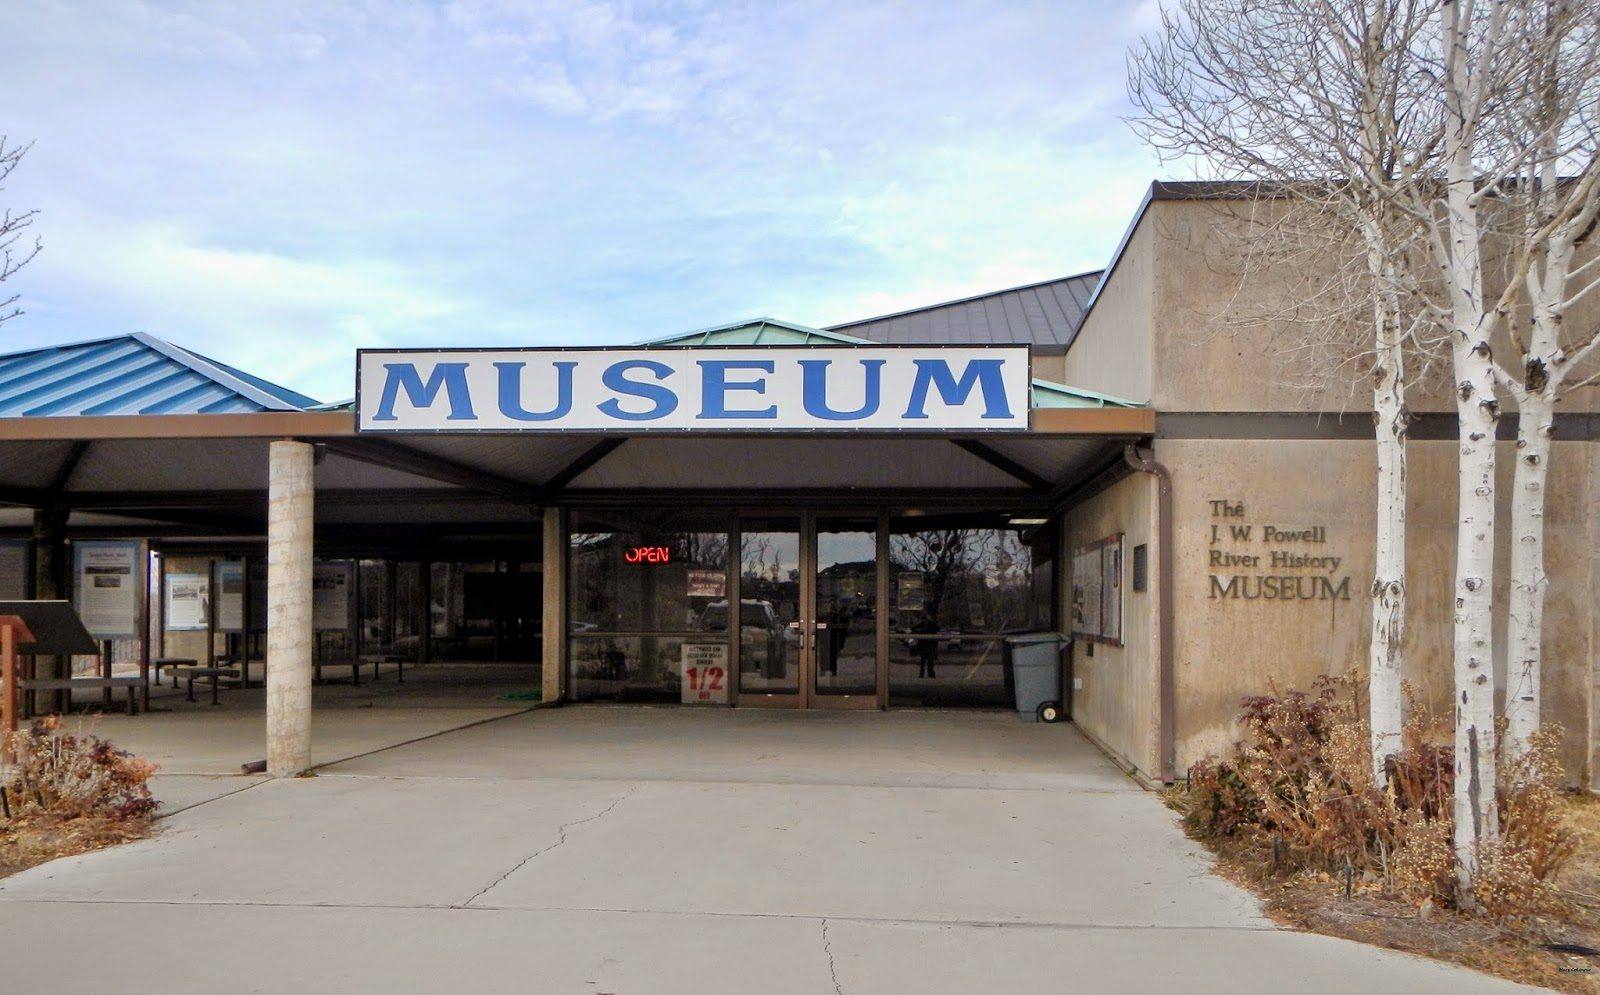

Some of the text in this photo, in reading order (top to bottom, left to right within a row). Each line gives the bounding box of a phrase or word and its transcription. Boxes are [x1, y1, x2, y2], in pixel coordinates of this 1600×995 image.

[372, 359, 1015, 421] MUSEUM
[1209, 500, 1245, 517] The
[1230, 525, 1252, 542] W.
[1263, 526, 1326, 543] Powell
[625, 547, 669, 563] OPEN
[1209, 550, 1341, 573] River History
[1208, 575, 1351, 601] MUSEUM
[686, 666, 724, 691] 1/2
